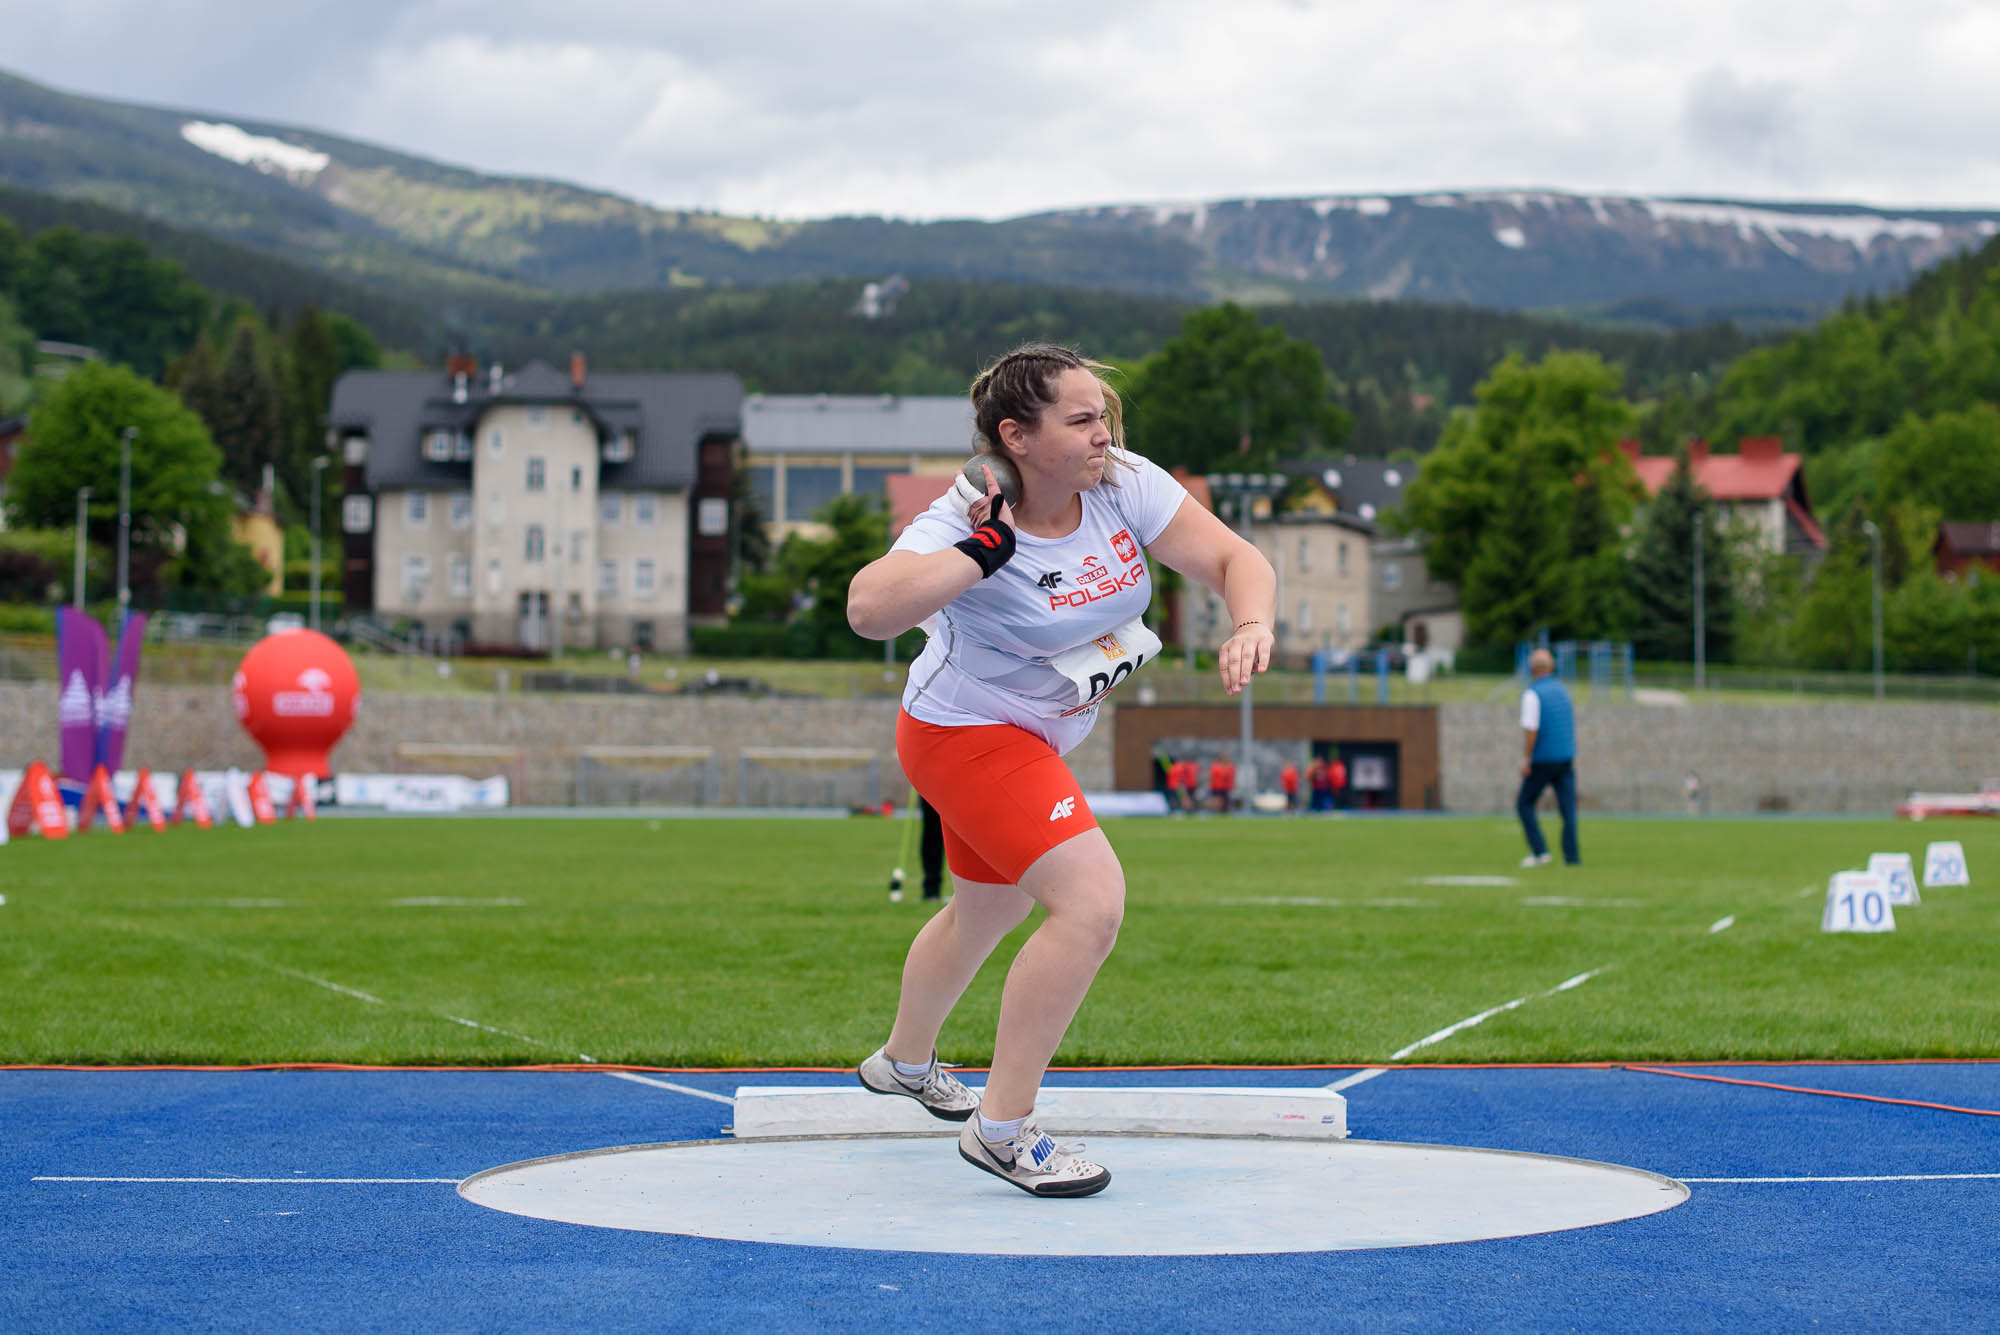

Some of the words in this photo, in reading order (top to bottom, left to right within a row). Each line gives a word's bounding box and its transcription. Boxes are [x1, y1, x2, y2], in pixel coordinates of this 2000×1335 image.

[1048, 563, 1145, 611] POLSKA
[1077, 566, 1107, 585] ORLEN
[1932, 856, 1961, 880] 20
[1841, 891, 1884, 926] 10
